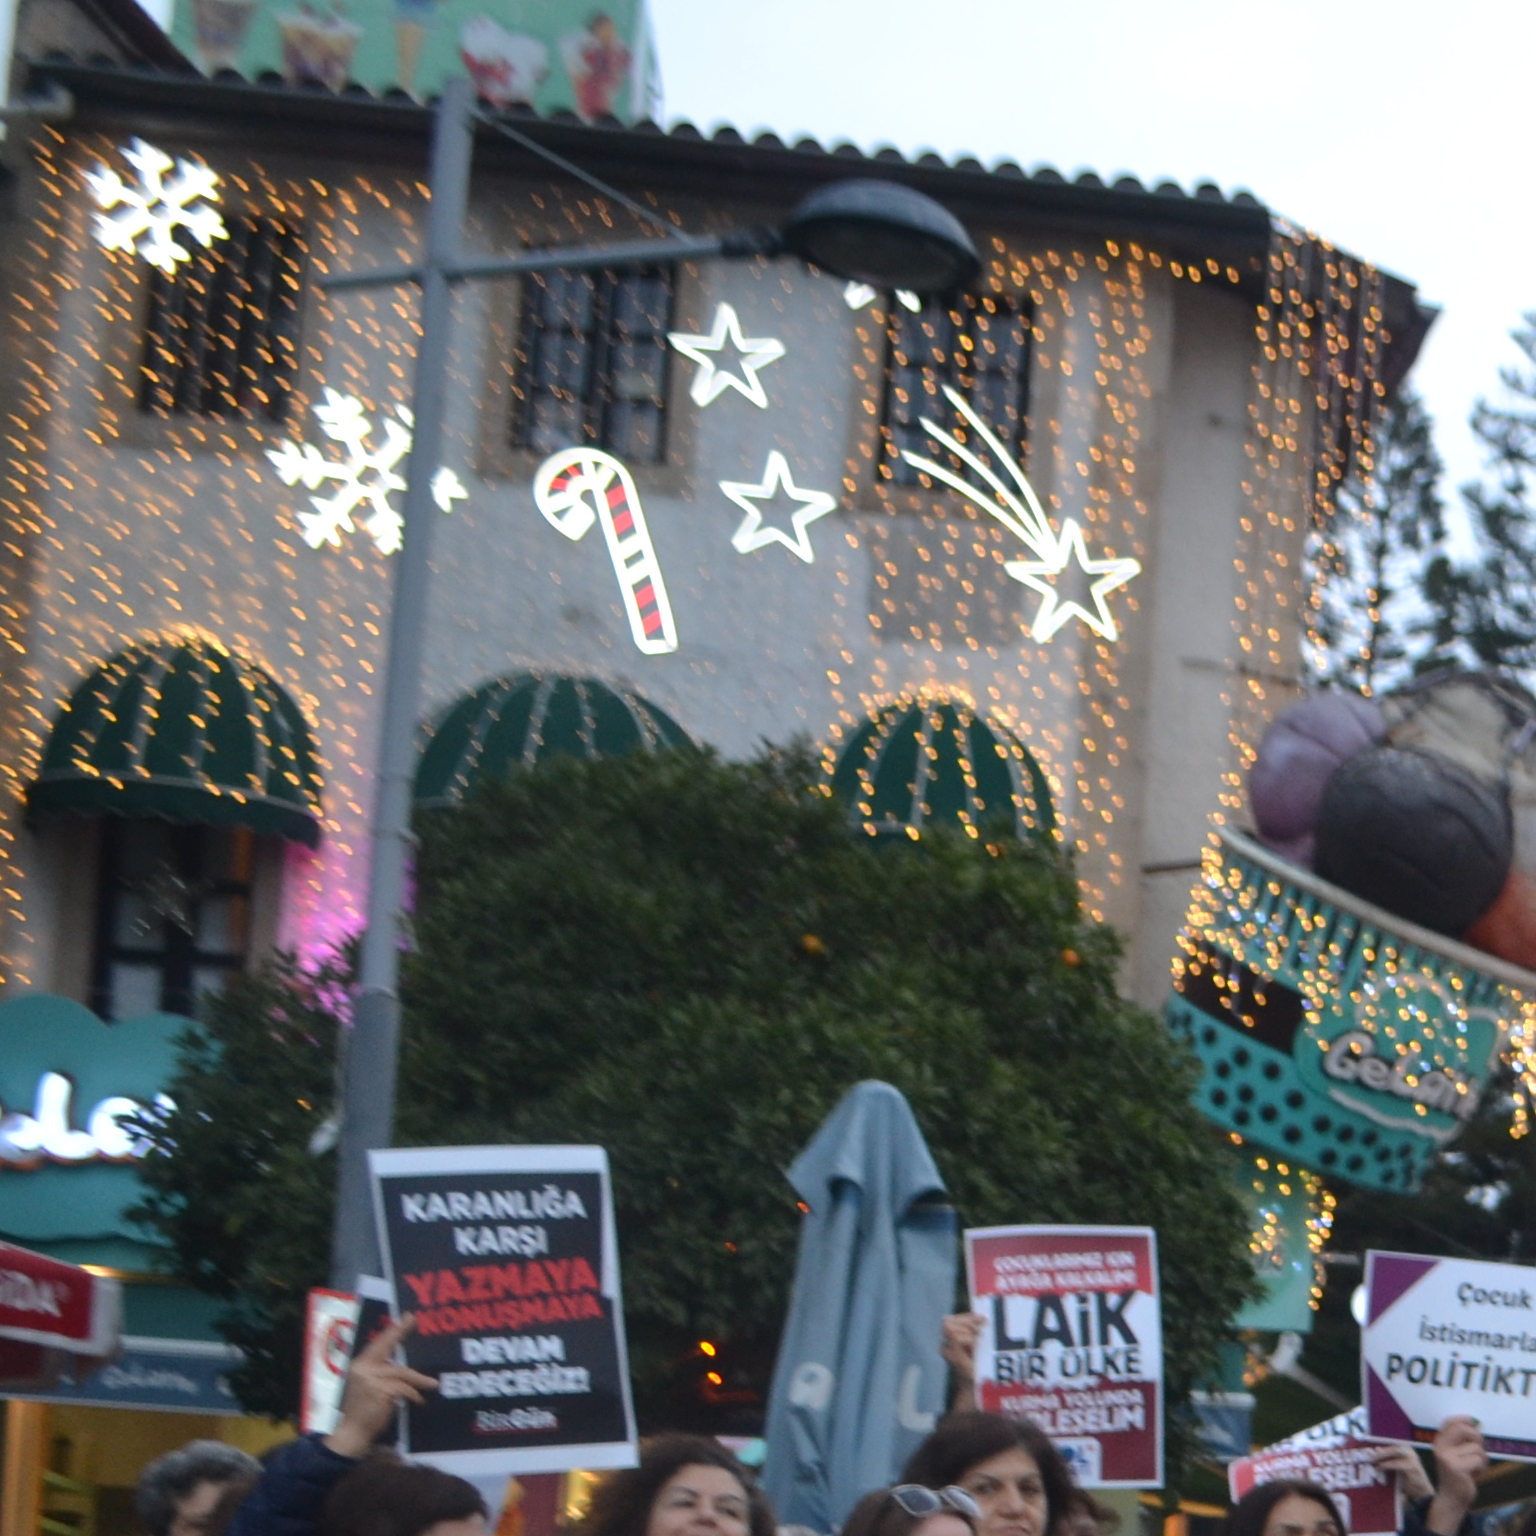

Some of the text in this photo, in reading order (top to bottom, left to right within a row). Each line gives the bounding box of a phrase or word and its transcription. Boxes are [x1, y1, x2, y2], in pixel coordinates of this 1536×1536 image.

[401, 1184, 588, 1223] KARANLIĞA
[453, 1225, 549, 1258] KARŞI
[404, 1256, 600, 1306] YAZMAYA
[1457, 1282, 1533, 1311] Çocuk
[415, 1293, 604, 1336] KONUŞMAYA
[460, 1334, 566, 1366] DEVAM
[995, 1352, 1141, 1382] BİR ÜLKE
